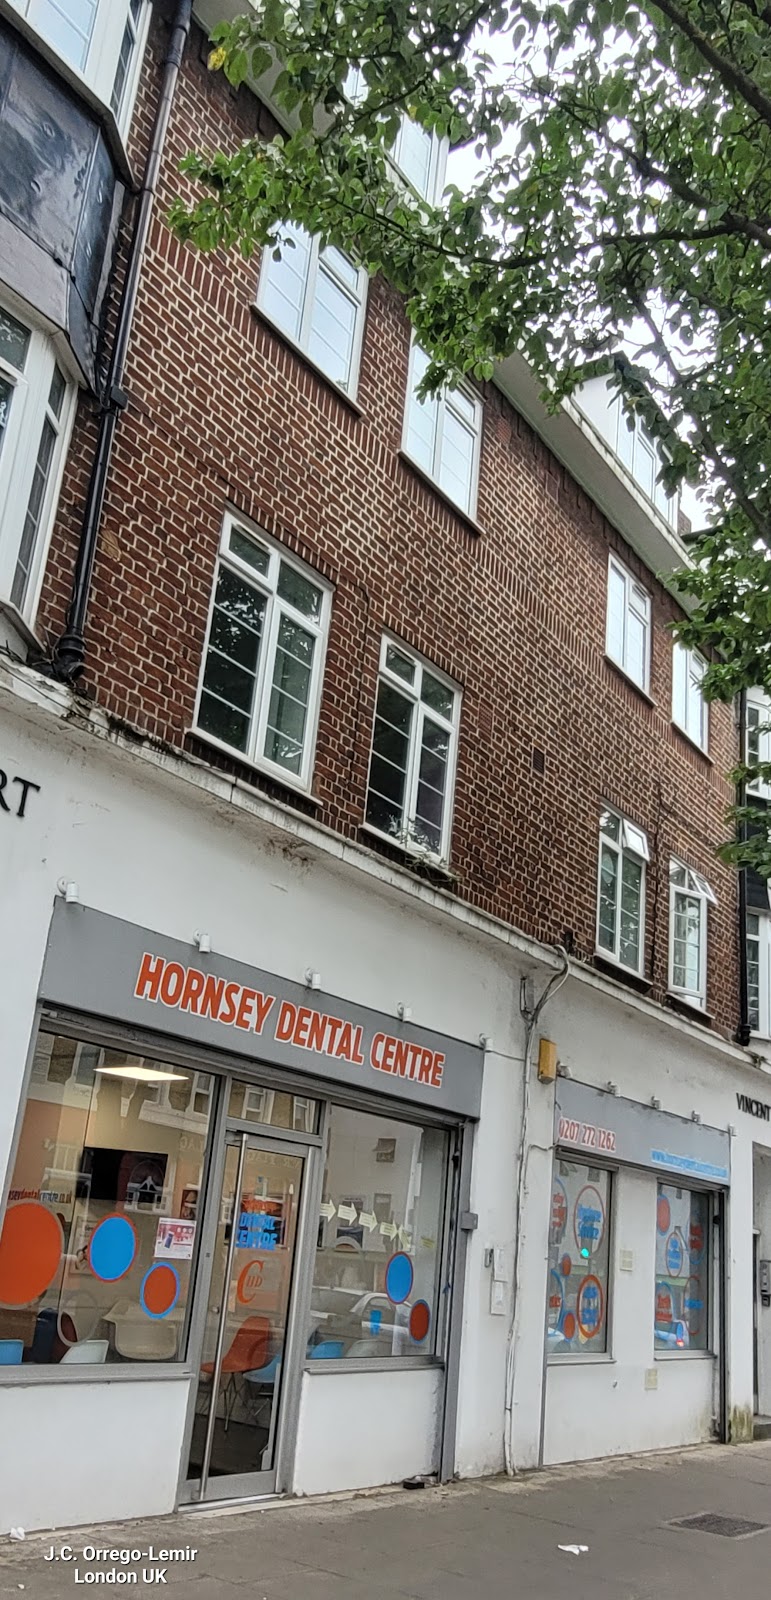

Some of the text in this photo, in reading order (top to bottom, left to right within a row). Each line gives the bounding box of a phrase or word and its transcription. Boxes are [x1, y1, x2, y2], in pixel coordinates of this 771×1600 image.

[134, 951, 446, 1089] HORNSEY DENTAL CENTRE
[735, 1092, 771, 1122] VINCENT
[558, 1117, 617, 1153] 0207 272 1262
[239, 1211, 276, 1231] DENTAL
[237, 1230, 278, 1250] ENTRE
